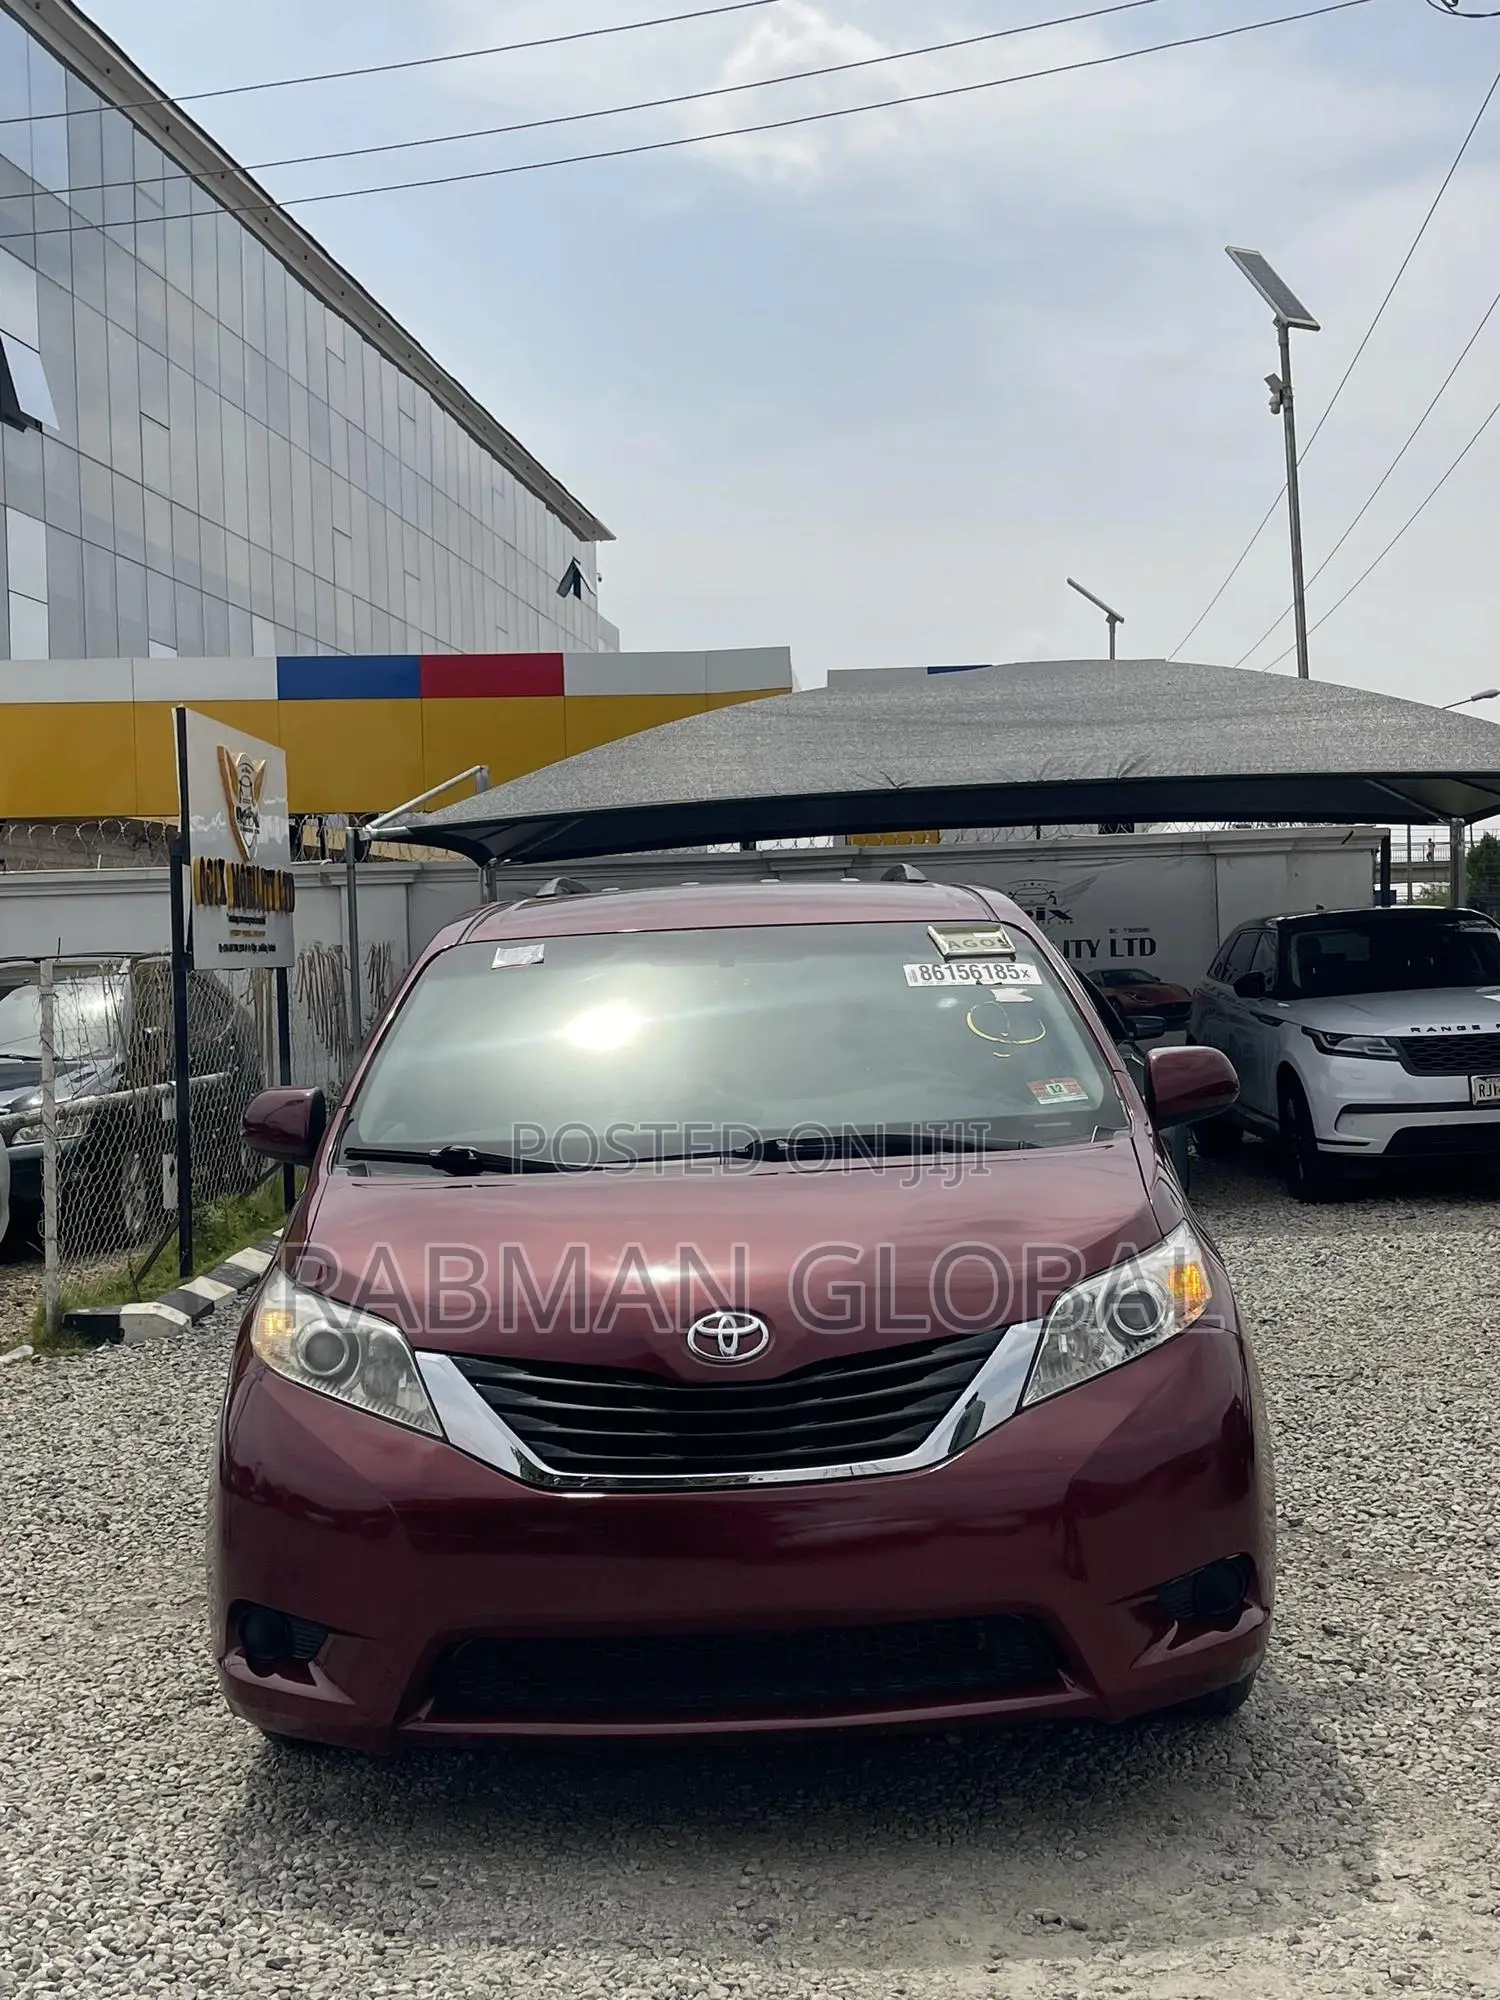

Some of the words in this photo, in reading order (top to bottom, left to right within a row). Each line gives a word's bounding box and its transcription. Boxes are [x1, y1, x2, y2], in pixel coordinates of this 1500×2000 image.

[1064, 939, 1100, 958] ITY
[1110, 937, 1157, 958] LTD
[1410, 1024, 1481, 1033] RANGE
